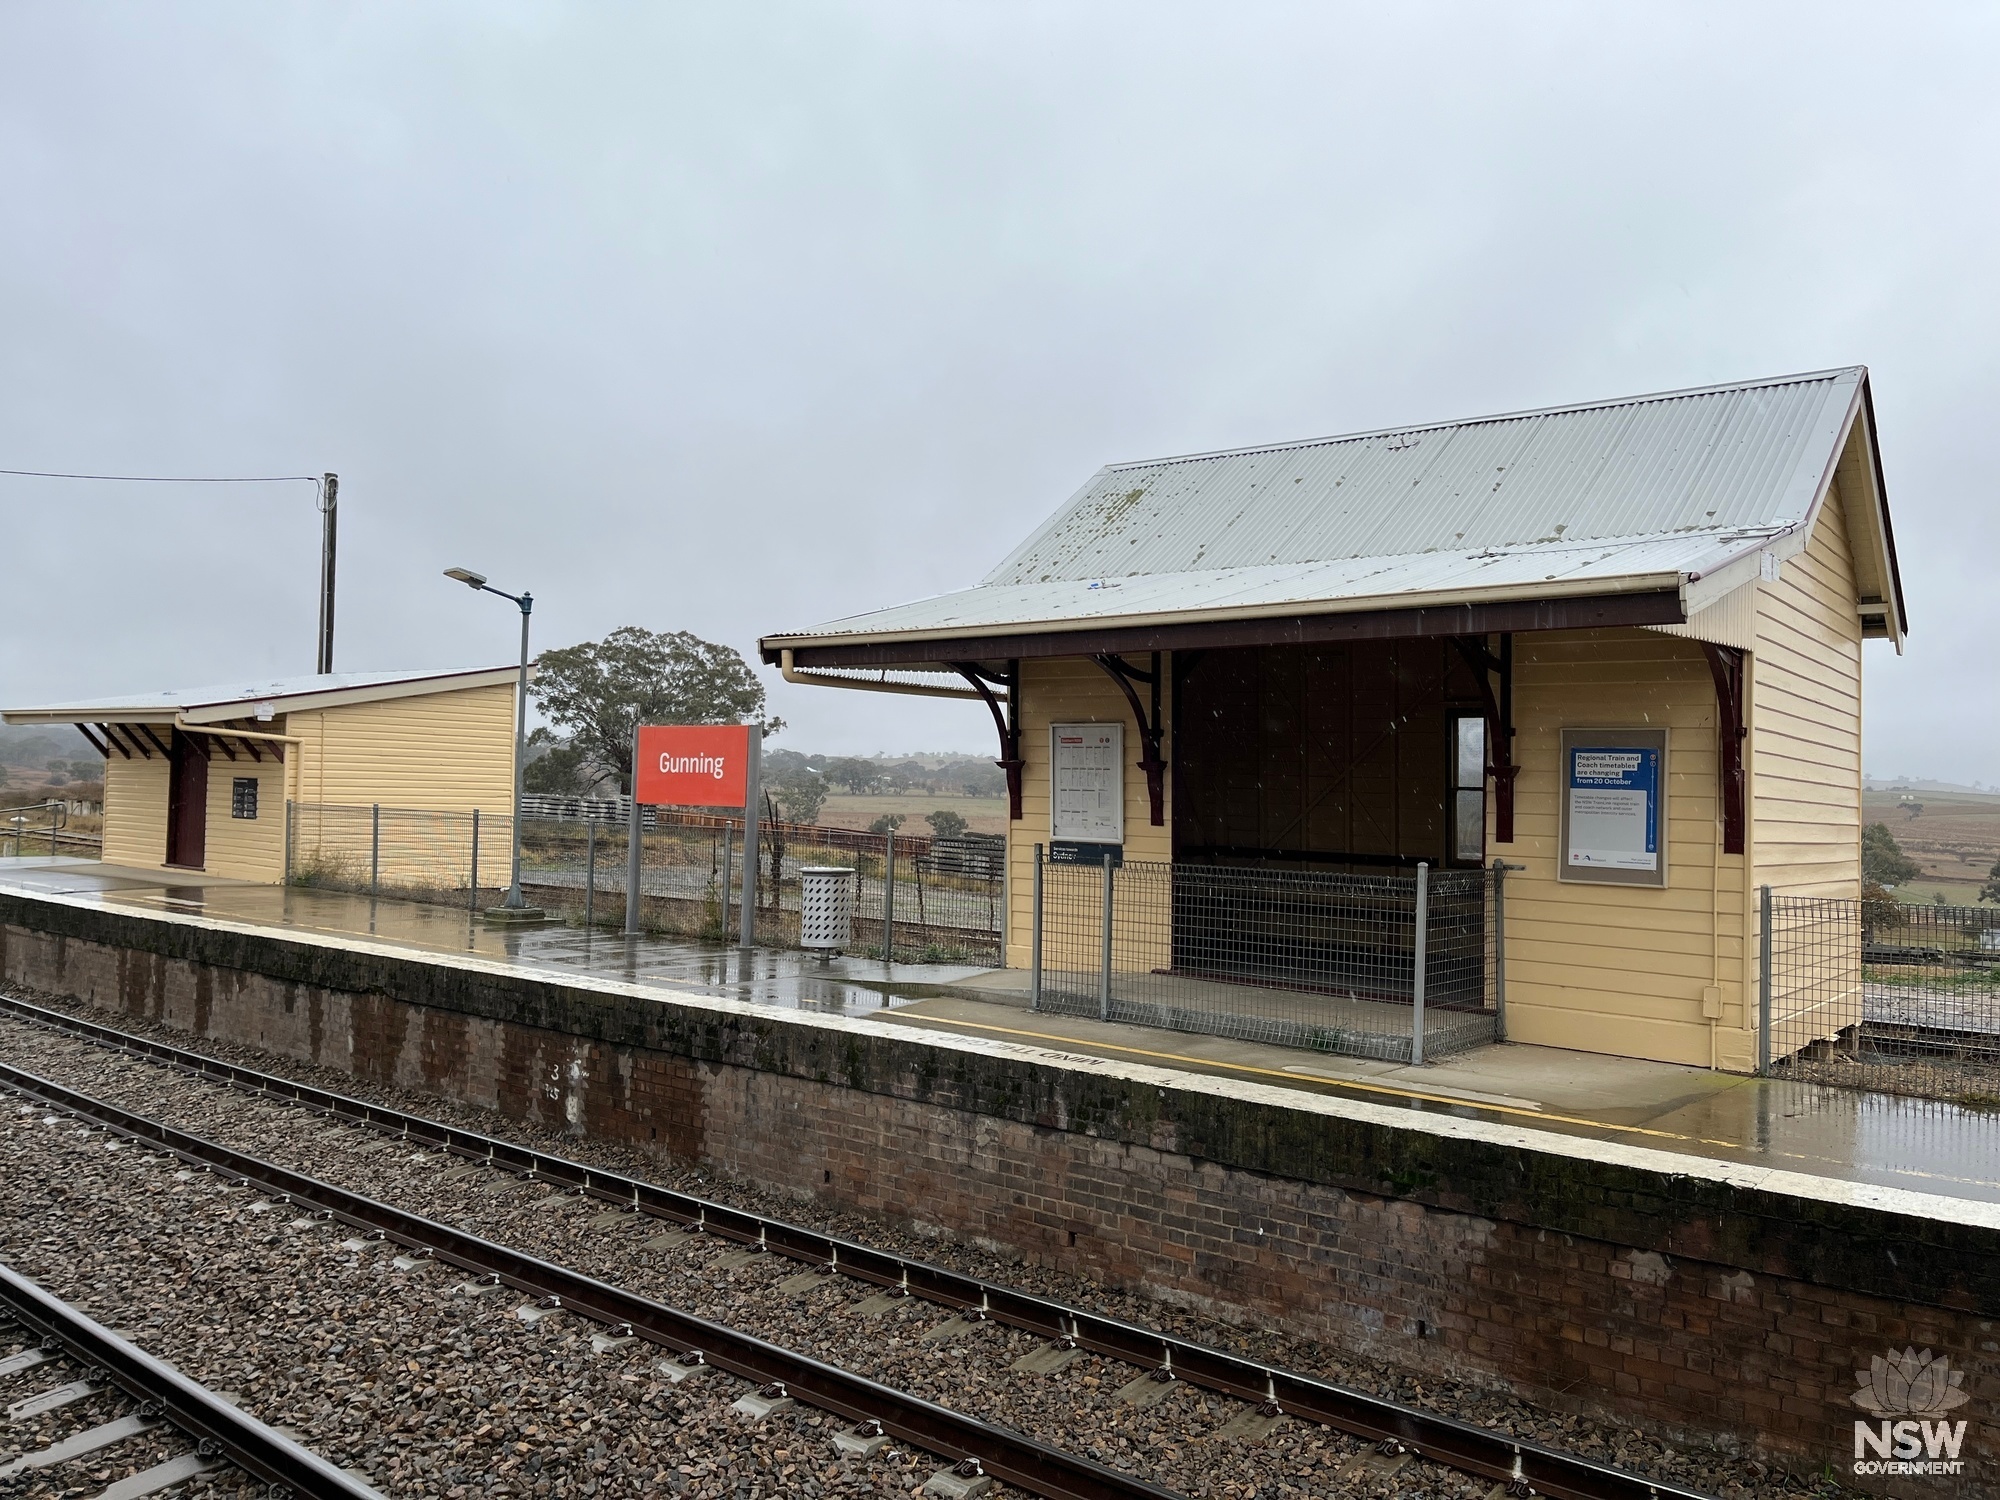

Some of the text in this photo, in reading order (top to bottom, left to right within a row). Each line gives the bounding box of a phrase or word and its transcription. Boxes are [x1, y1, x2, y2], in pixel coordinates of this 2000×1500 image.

[659, 752, 724, 779] Gunning
[1053, 851, 1077, 861] Sydney
[995, 1042, 1035, 1054] THE
[1039, 1051, 1106, 1065] MIND
